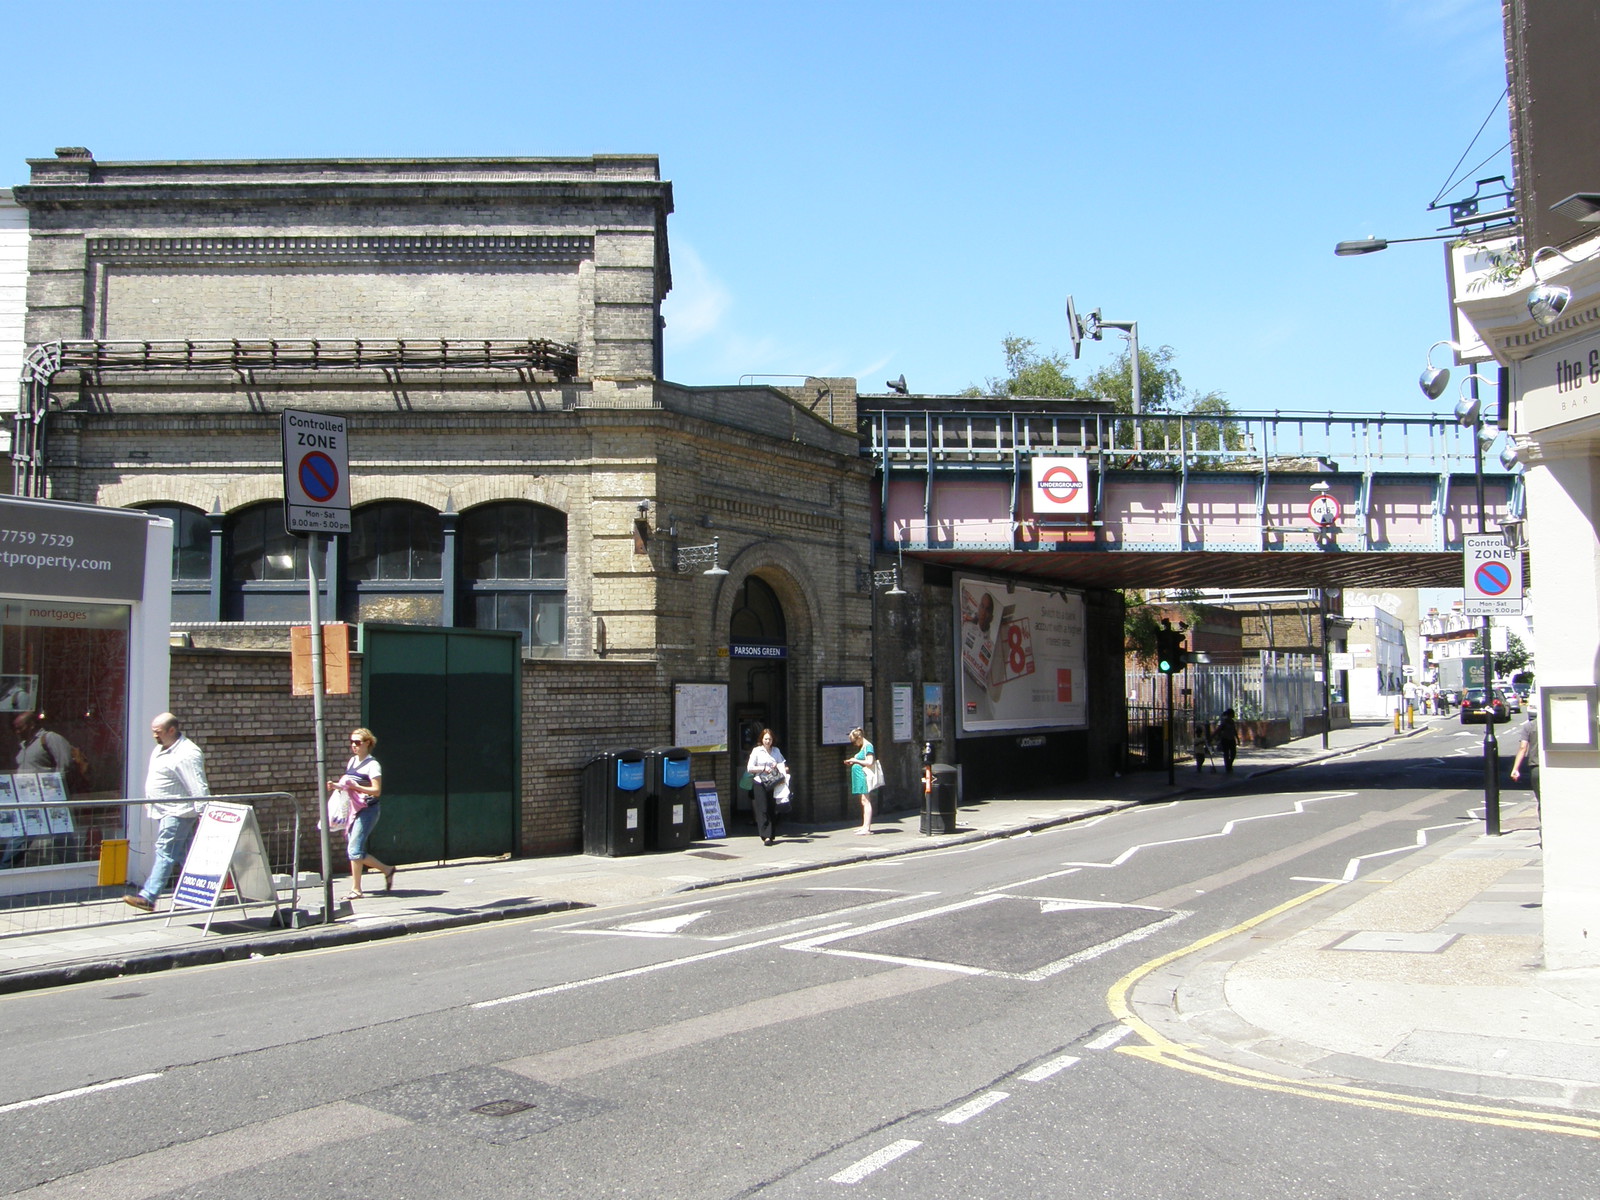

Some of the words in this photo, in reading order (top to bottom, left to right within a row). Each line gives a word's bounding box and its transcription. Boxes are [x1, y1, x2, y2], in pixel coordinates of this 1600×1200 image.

[1556, 359, 1582, 394] the
[1561, 395, 1588, 410] BAR
[289, 415, 344, 432] Controlled
[297, 432, 336, 450] ZONE
[1, 529, 36, 544] 7759
[41, 533, 74, 548] 7529
[1467, 539, 1505, 547] Control
[0, 551, 112, 571] tproperty.com
[1475, 549, 1511, 559] ZONE
[29, 608, 87, 622] mortgages
[734, 646, 761, 655] PARSONS
[761, 647, 781, 656] GREEN
